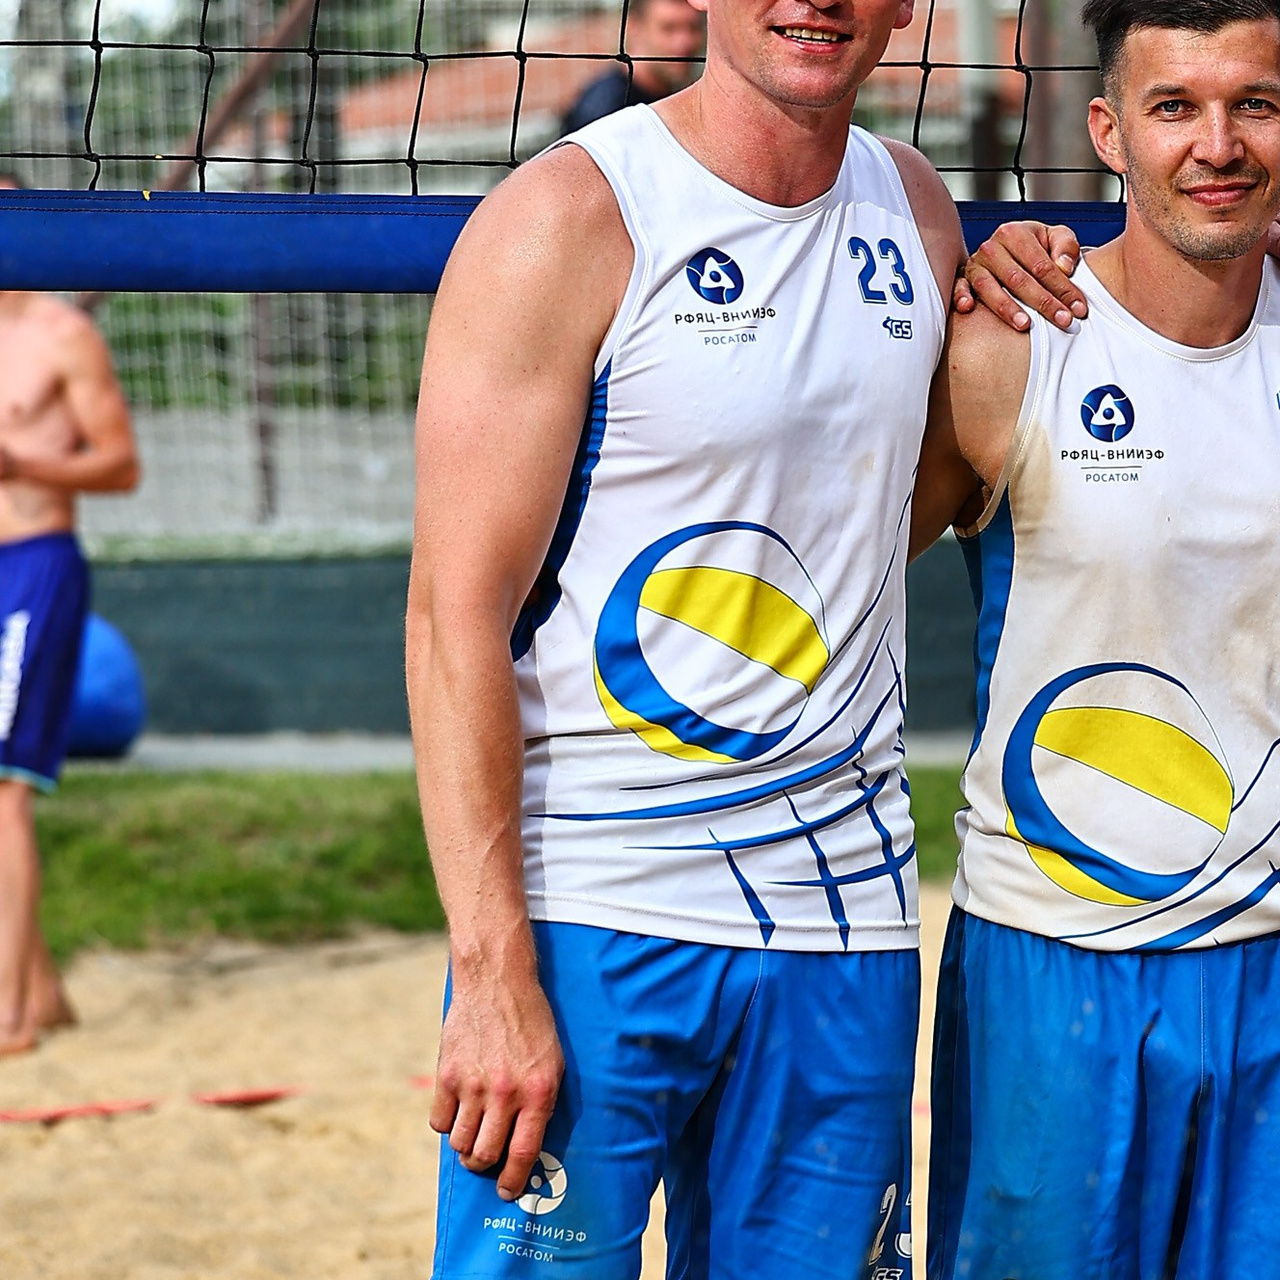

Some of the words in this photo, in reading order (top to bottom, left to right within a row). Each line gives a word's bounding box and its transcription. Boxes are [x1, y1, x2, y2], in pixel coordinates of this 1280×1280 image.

[847, 236, 914, 305] 23
[674, 307, 776, 325] РФЯЦ-ВНИИЭФ
[704, 333, 757, 346] РОСАТОМ
[1061, 448, 1165, 462] РФЯЦ-ВНИИЭФ
[1085, 472, 1139, 483] РОСАТОМ
[484, 1217, 587, 1242] РФЯЦ-ВНИИЭФ
[498, 1242, 554, 1262] РОСАТОМ
